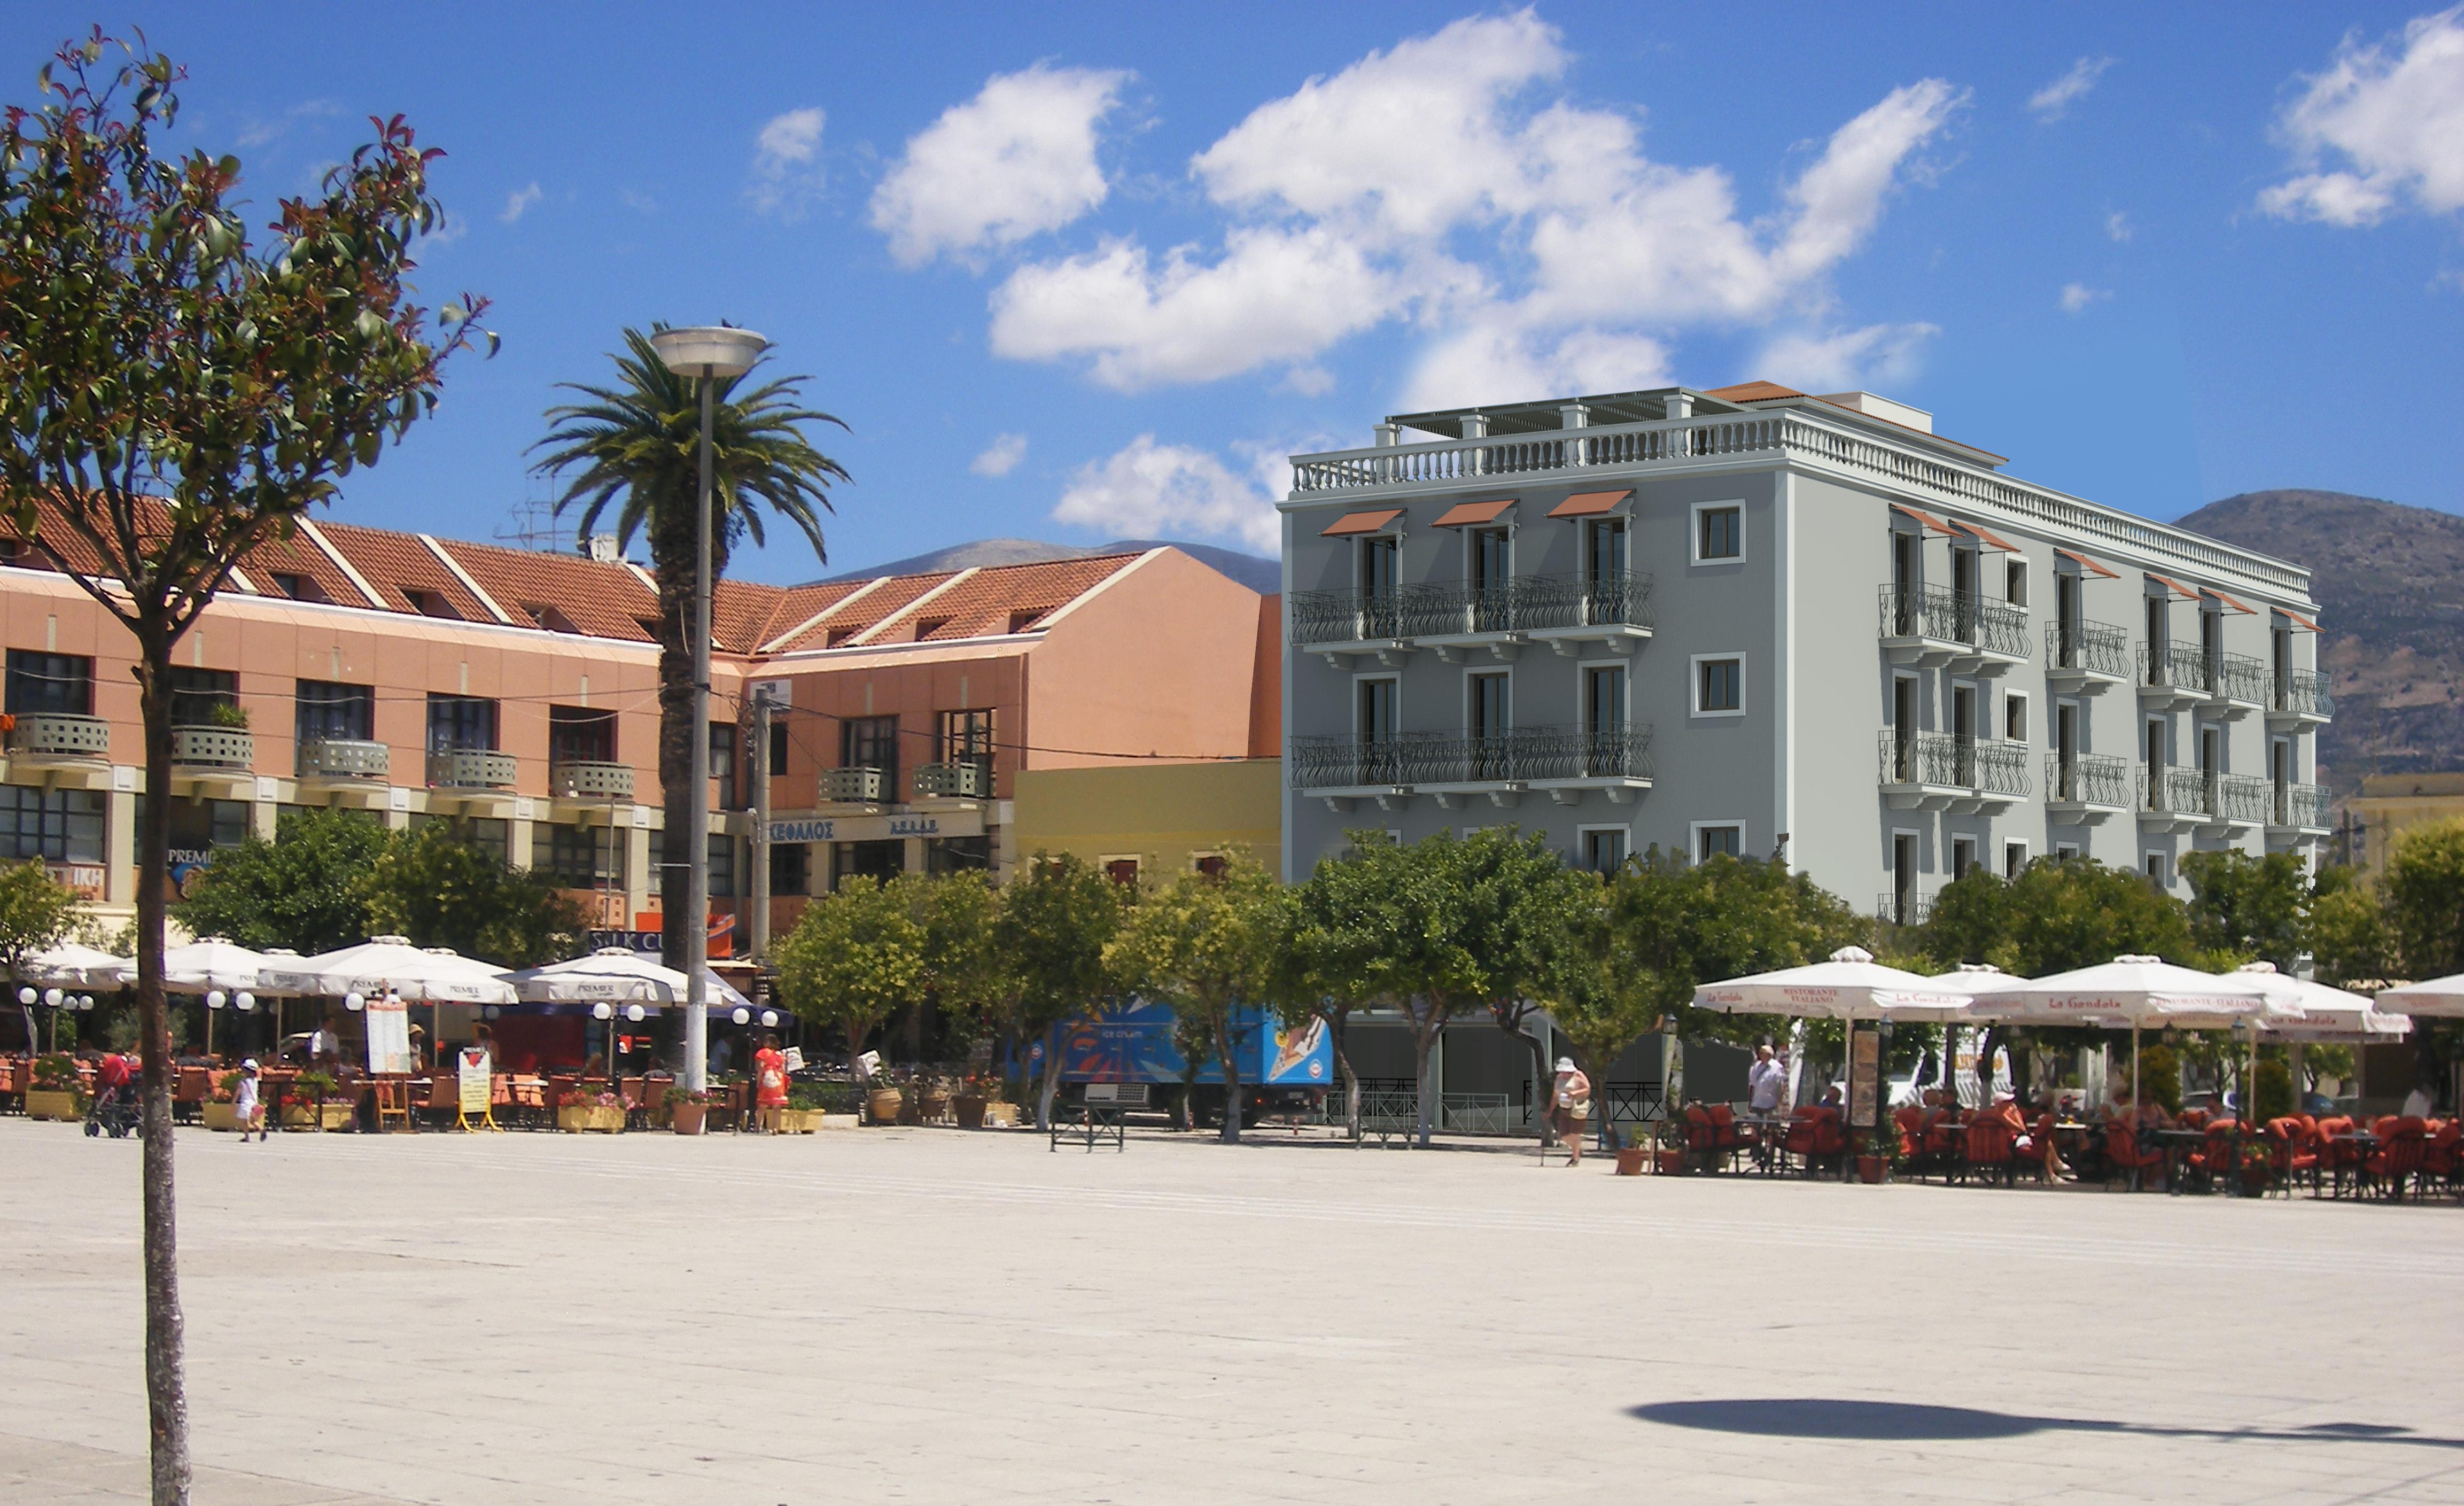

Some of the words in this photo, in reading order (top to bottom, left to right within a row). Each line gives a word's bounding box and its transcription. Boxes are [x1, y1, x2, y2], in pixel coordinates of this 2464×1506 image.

[449, 986, 479, 995] PREMIER
[578, 985, 614, 993] PREMIER
[1784, 989, 1837, 997] RISTORANTE
[1791, 996, 1834, 1004] ITALIANO
